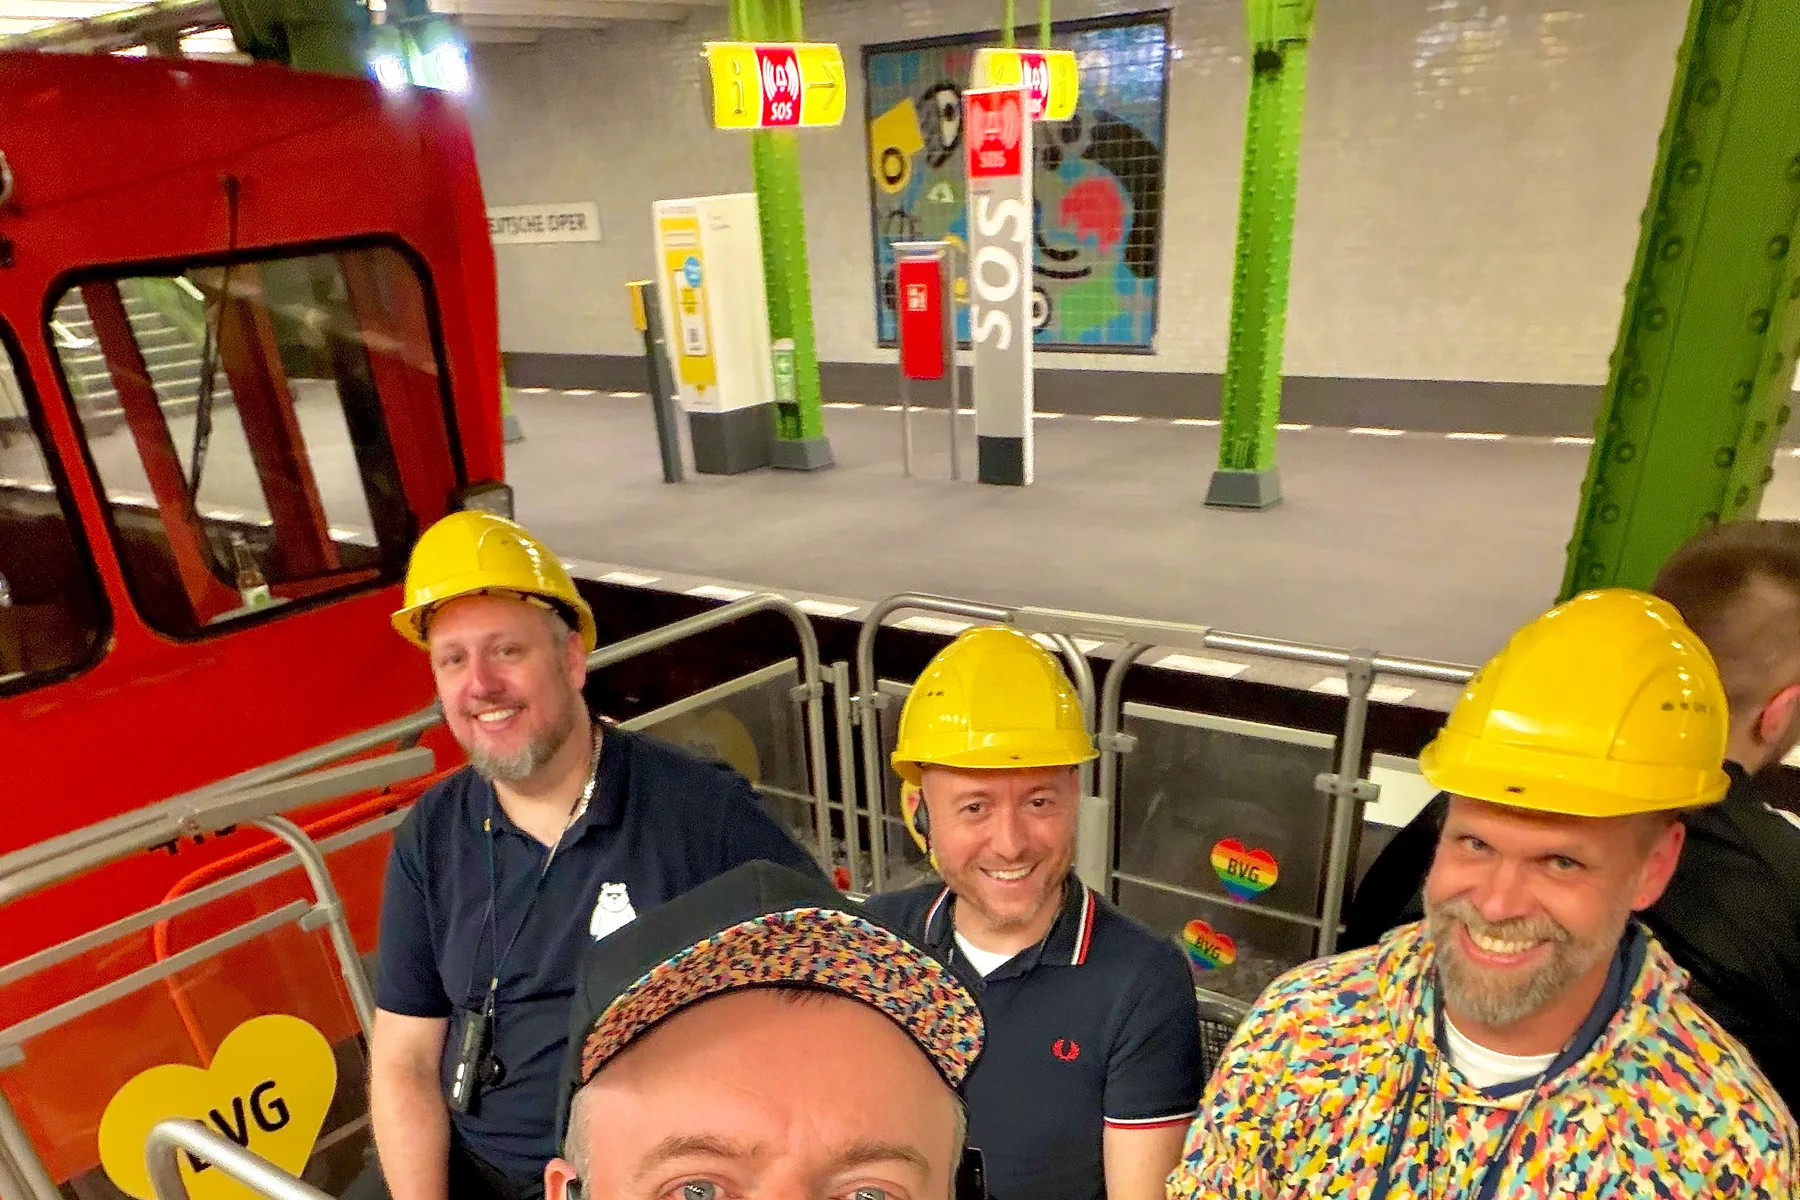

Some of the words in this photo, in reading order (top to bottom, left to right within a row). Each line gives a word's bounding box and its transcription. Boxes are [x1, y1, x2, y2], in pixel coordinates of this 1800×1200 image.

[770, 102, 793, 121] SOS
[970, 194, 1027, 350] SOS
[1227, 857, 1260, 883] BVG
[1196, 936, 1221, 960] BVG
[184, 1080, 290, 1172] VG
